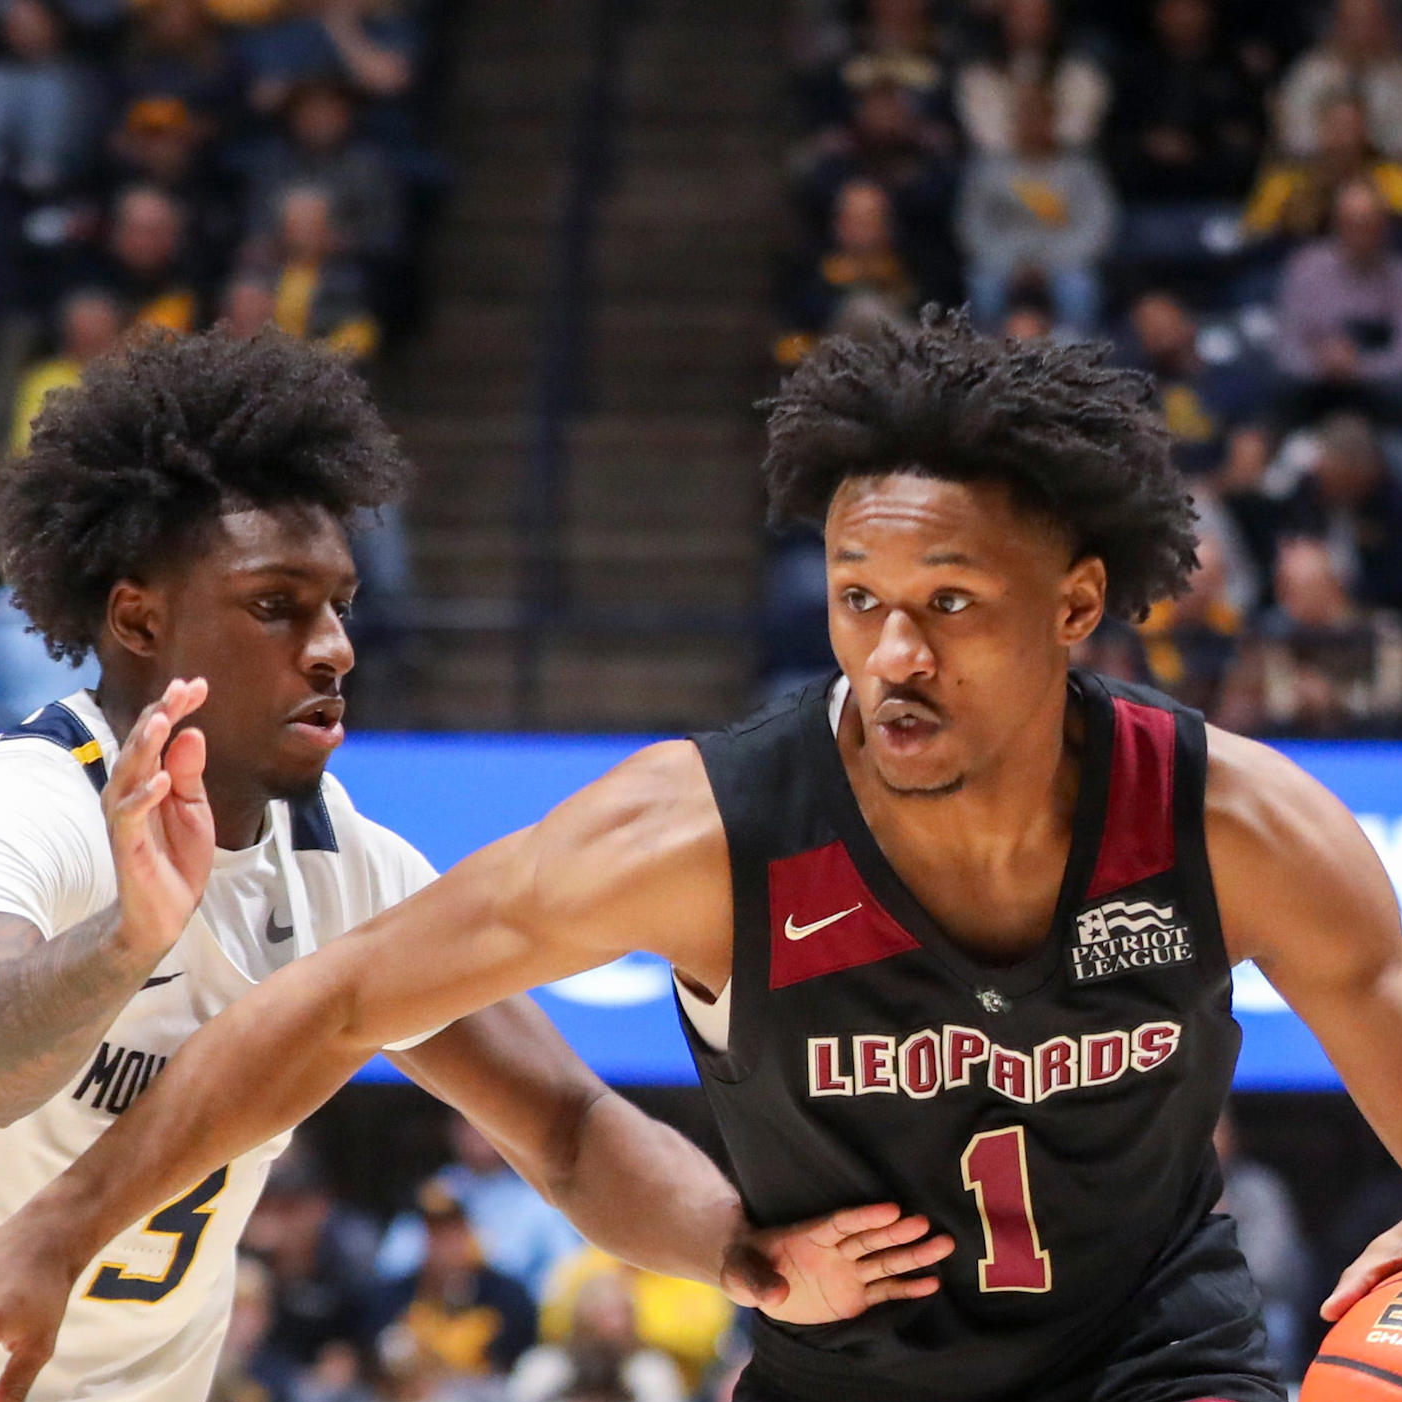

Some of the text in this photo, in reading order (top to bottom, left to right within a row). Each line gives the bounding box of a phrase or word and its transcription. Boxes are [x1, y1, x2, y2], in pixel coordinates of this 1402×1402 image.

[1071, 926, 1189, 964] PATRIOT
[1074, 943, 1193, 980] LEAGUE
[807, 1021, 1182, 1104] LEOPARDS
[960, 1125, 1052, 1293] 1
